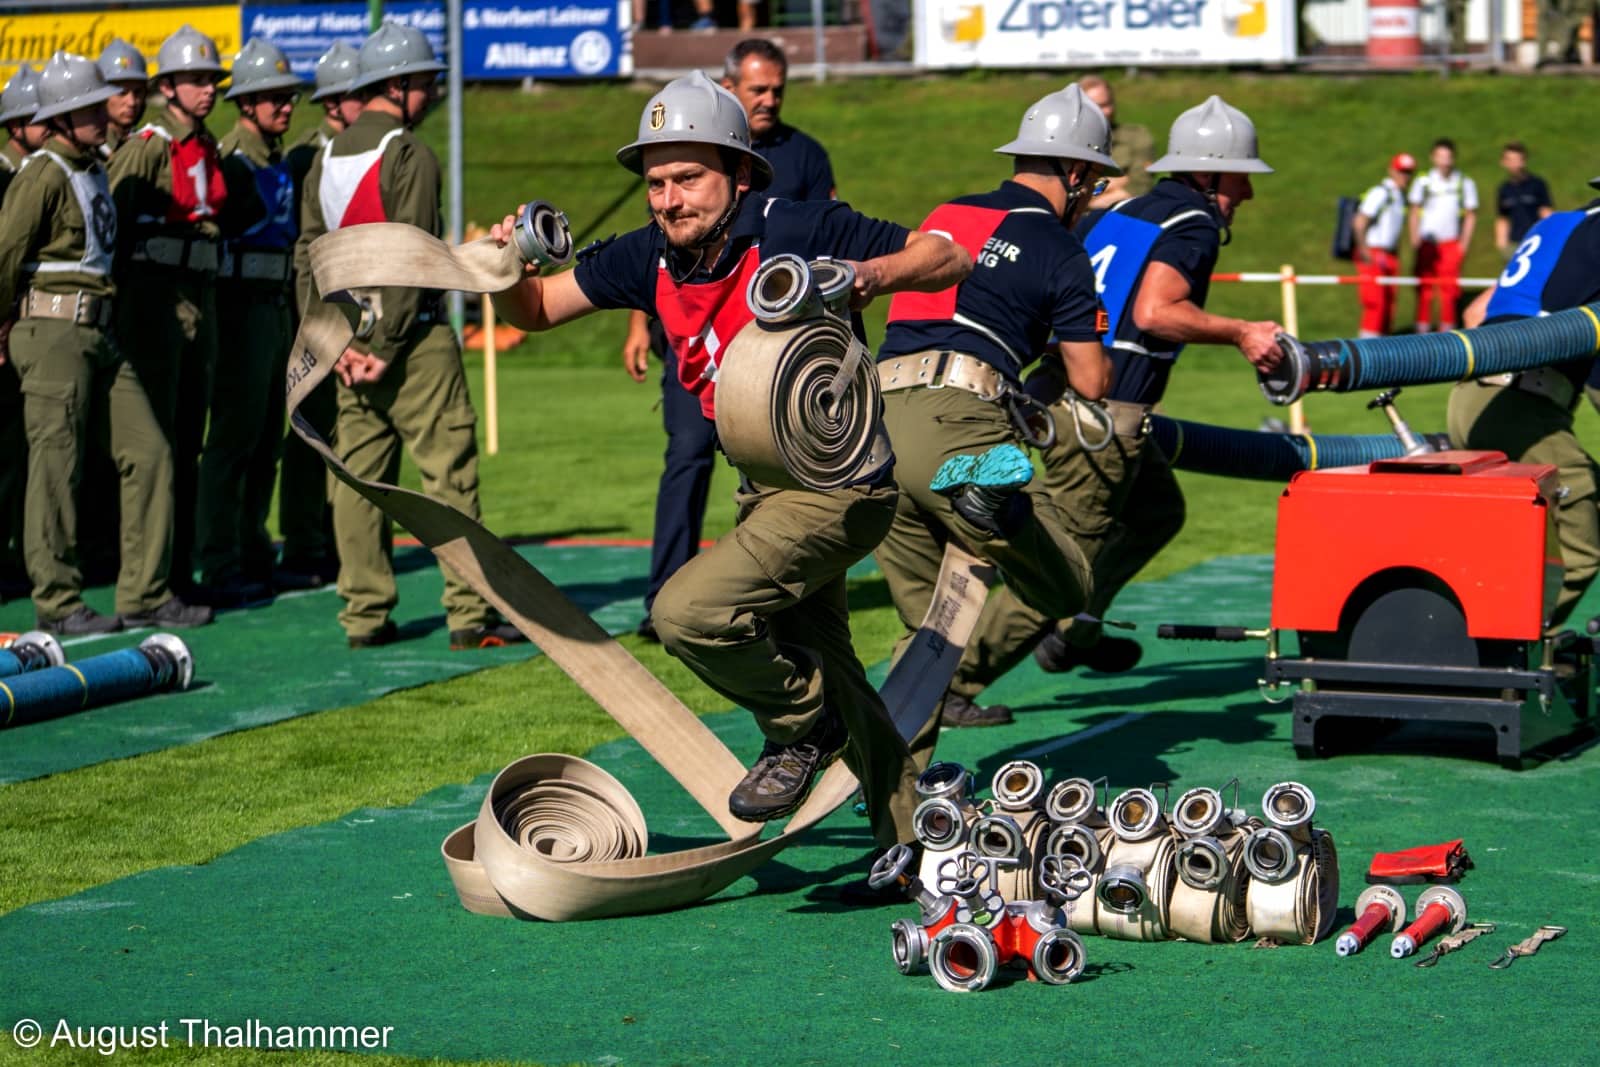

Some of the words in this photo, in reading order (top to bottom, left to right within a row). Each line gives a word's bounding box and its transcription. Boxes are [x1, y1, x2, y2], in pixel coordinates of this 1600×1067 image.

[252, 13, 317, 39] Agentur
[465, 7, 480, 29] &
[481, 6, 547, 28] Norbert
[1124, 0, 1208, 30] Bier
[484, 42, 568, 69] Allianz
[1499, 234, 1541, 288] 3
